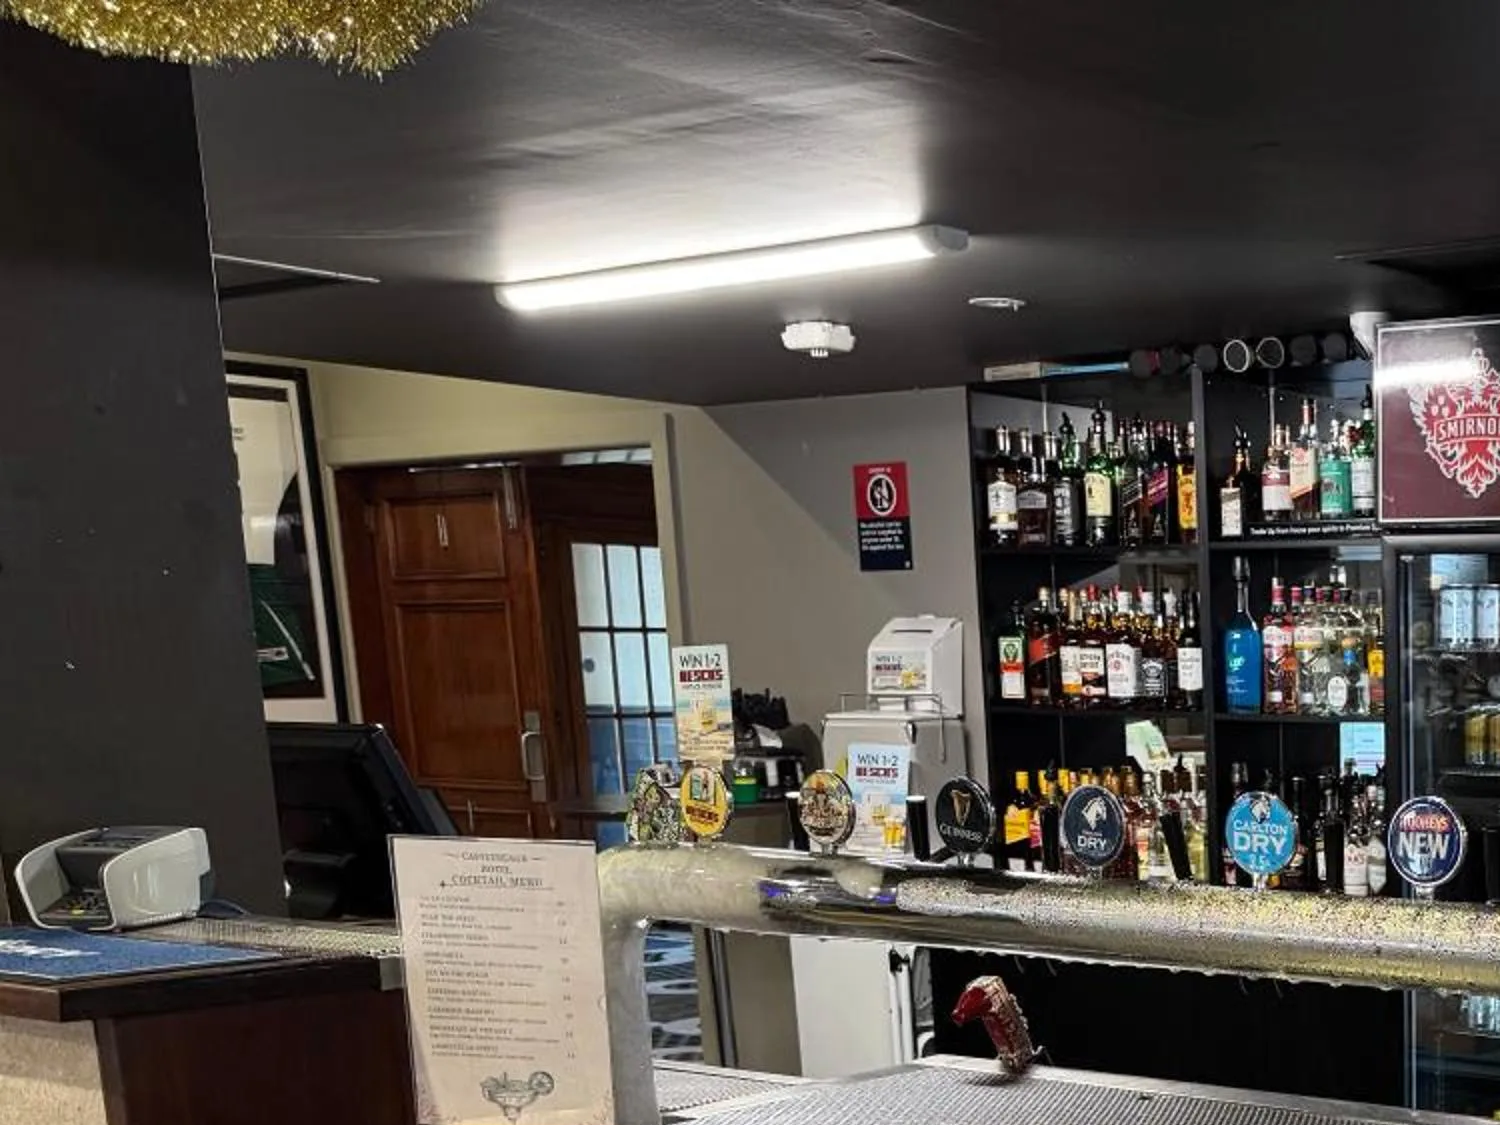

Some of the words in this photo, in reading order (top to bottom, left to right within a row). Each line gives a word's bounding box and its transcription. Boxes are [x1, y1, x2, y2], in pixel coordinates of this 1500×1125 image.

[857, 753, 879, 766] WIN
[1233, 819, 1288, 834] CARLTON
[1401, 813, 1450, 831] TOOHEYS
[940, 822, 983, 842] GUINNESS
[1077, 835, 1107, 851] DRY
[1233, 831, 1288, 855] DRY
[1397, 831, 1450, 860] NEW
